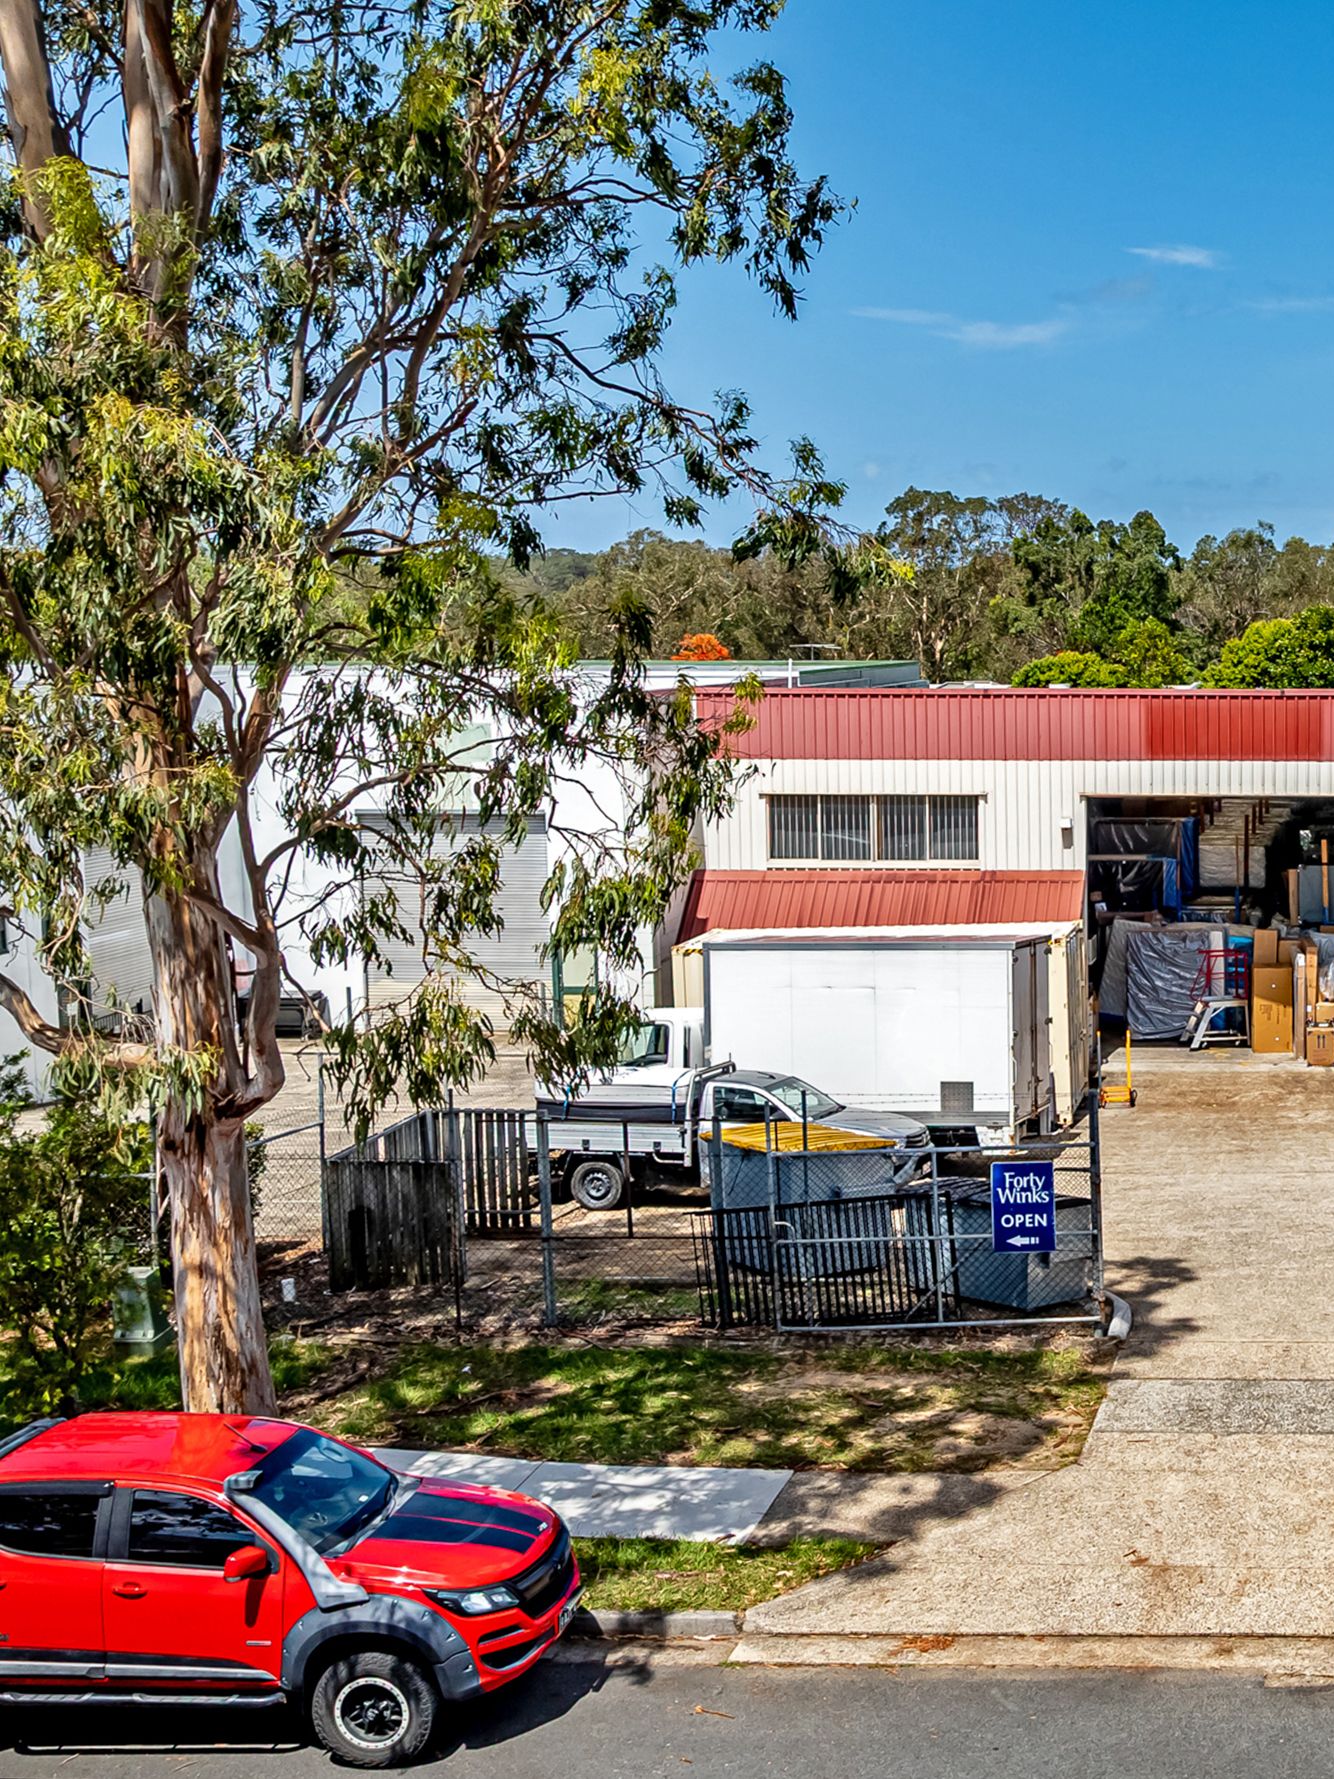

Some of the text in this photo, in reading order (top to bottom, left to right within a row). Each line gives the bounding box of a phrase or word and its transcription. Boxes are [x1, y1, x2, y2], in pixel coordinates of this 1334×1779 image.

[1003, 1172, 1046, 1191] Forty
[996, 1187, 1049, 1204] Winks
[1001, 1213, 1047, 1228] OPEN
